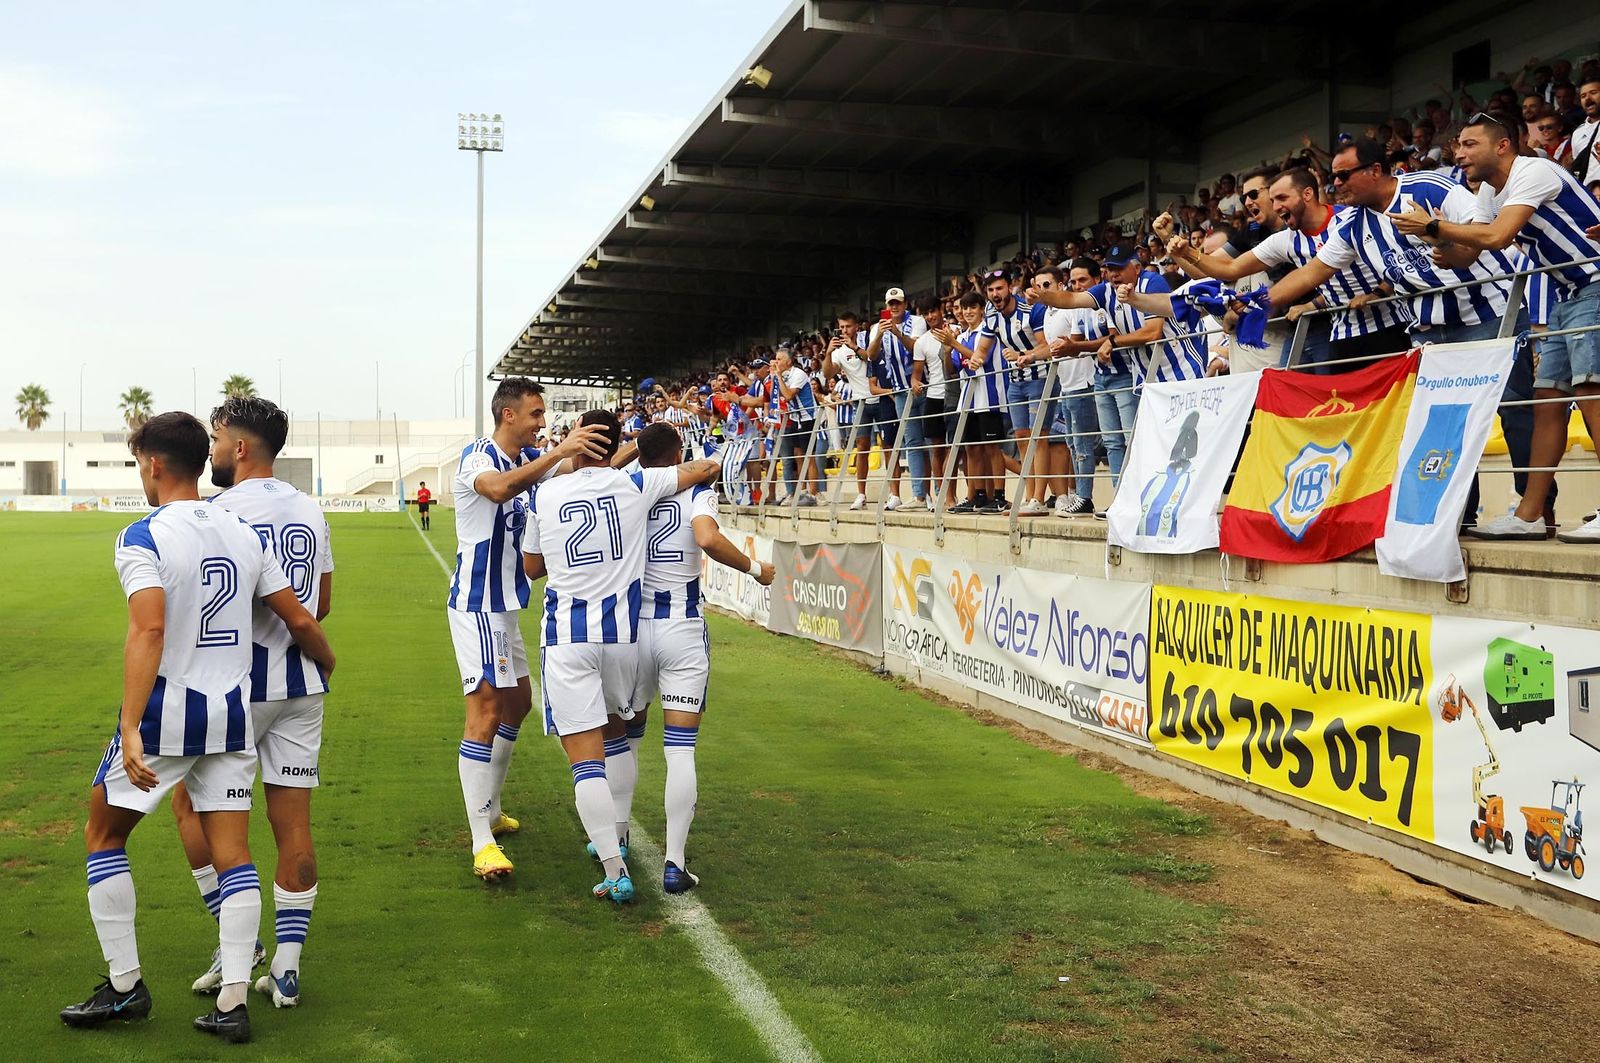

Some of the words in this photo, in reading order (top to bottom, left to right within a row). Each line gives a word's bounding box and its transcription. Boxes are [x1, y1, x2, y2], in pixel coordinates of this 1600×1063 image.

[1417, 376, 1454, 390] Orgullo
[559, 496, 623, 568] 21
[196, 556, 239, 648] 2
[984, 574, 1040, 657] Vélez
[1041, 597, 1147, 684] Alfonso
[952, 650, 1005, 689] FERRETERIA
[1013, 670, 1068, 709] PINTURAS
[1155, 598, 1234, 667] ALQUILER
[1239, 609, 1263, 675] DE
[1268, 612, 1425, 706] MAQUINARIA
[662, 694, 699, 706] ROMERO
[1158, 671, 1224, 752] 610
[1229, 693, 1314, 789] 705
[1323, 717, 1421, 828] 017
